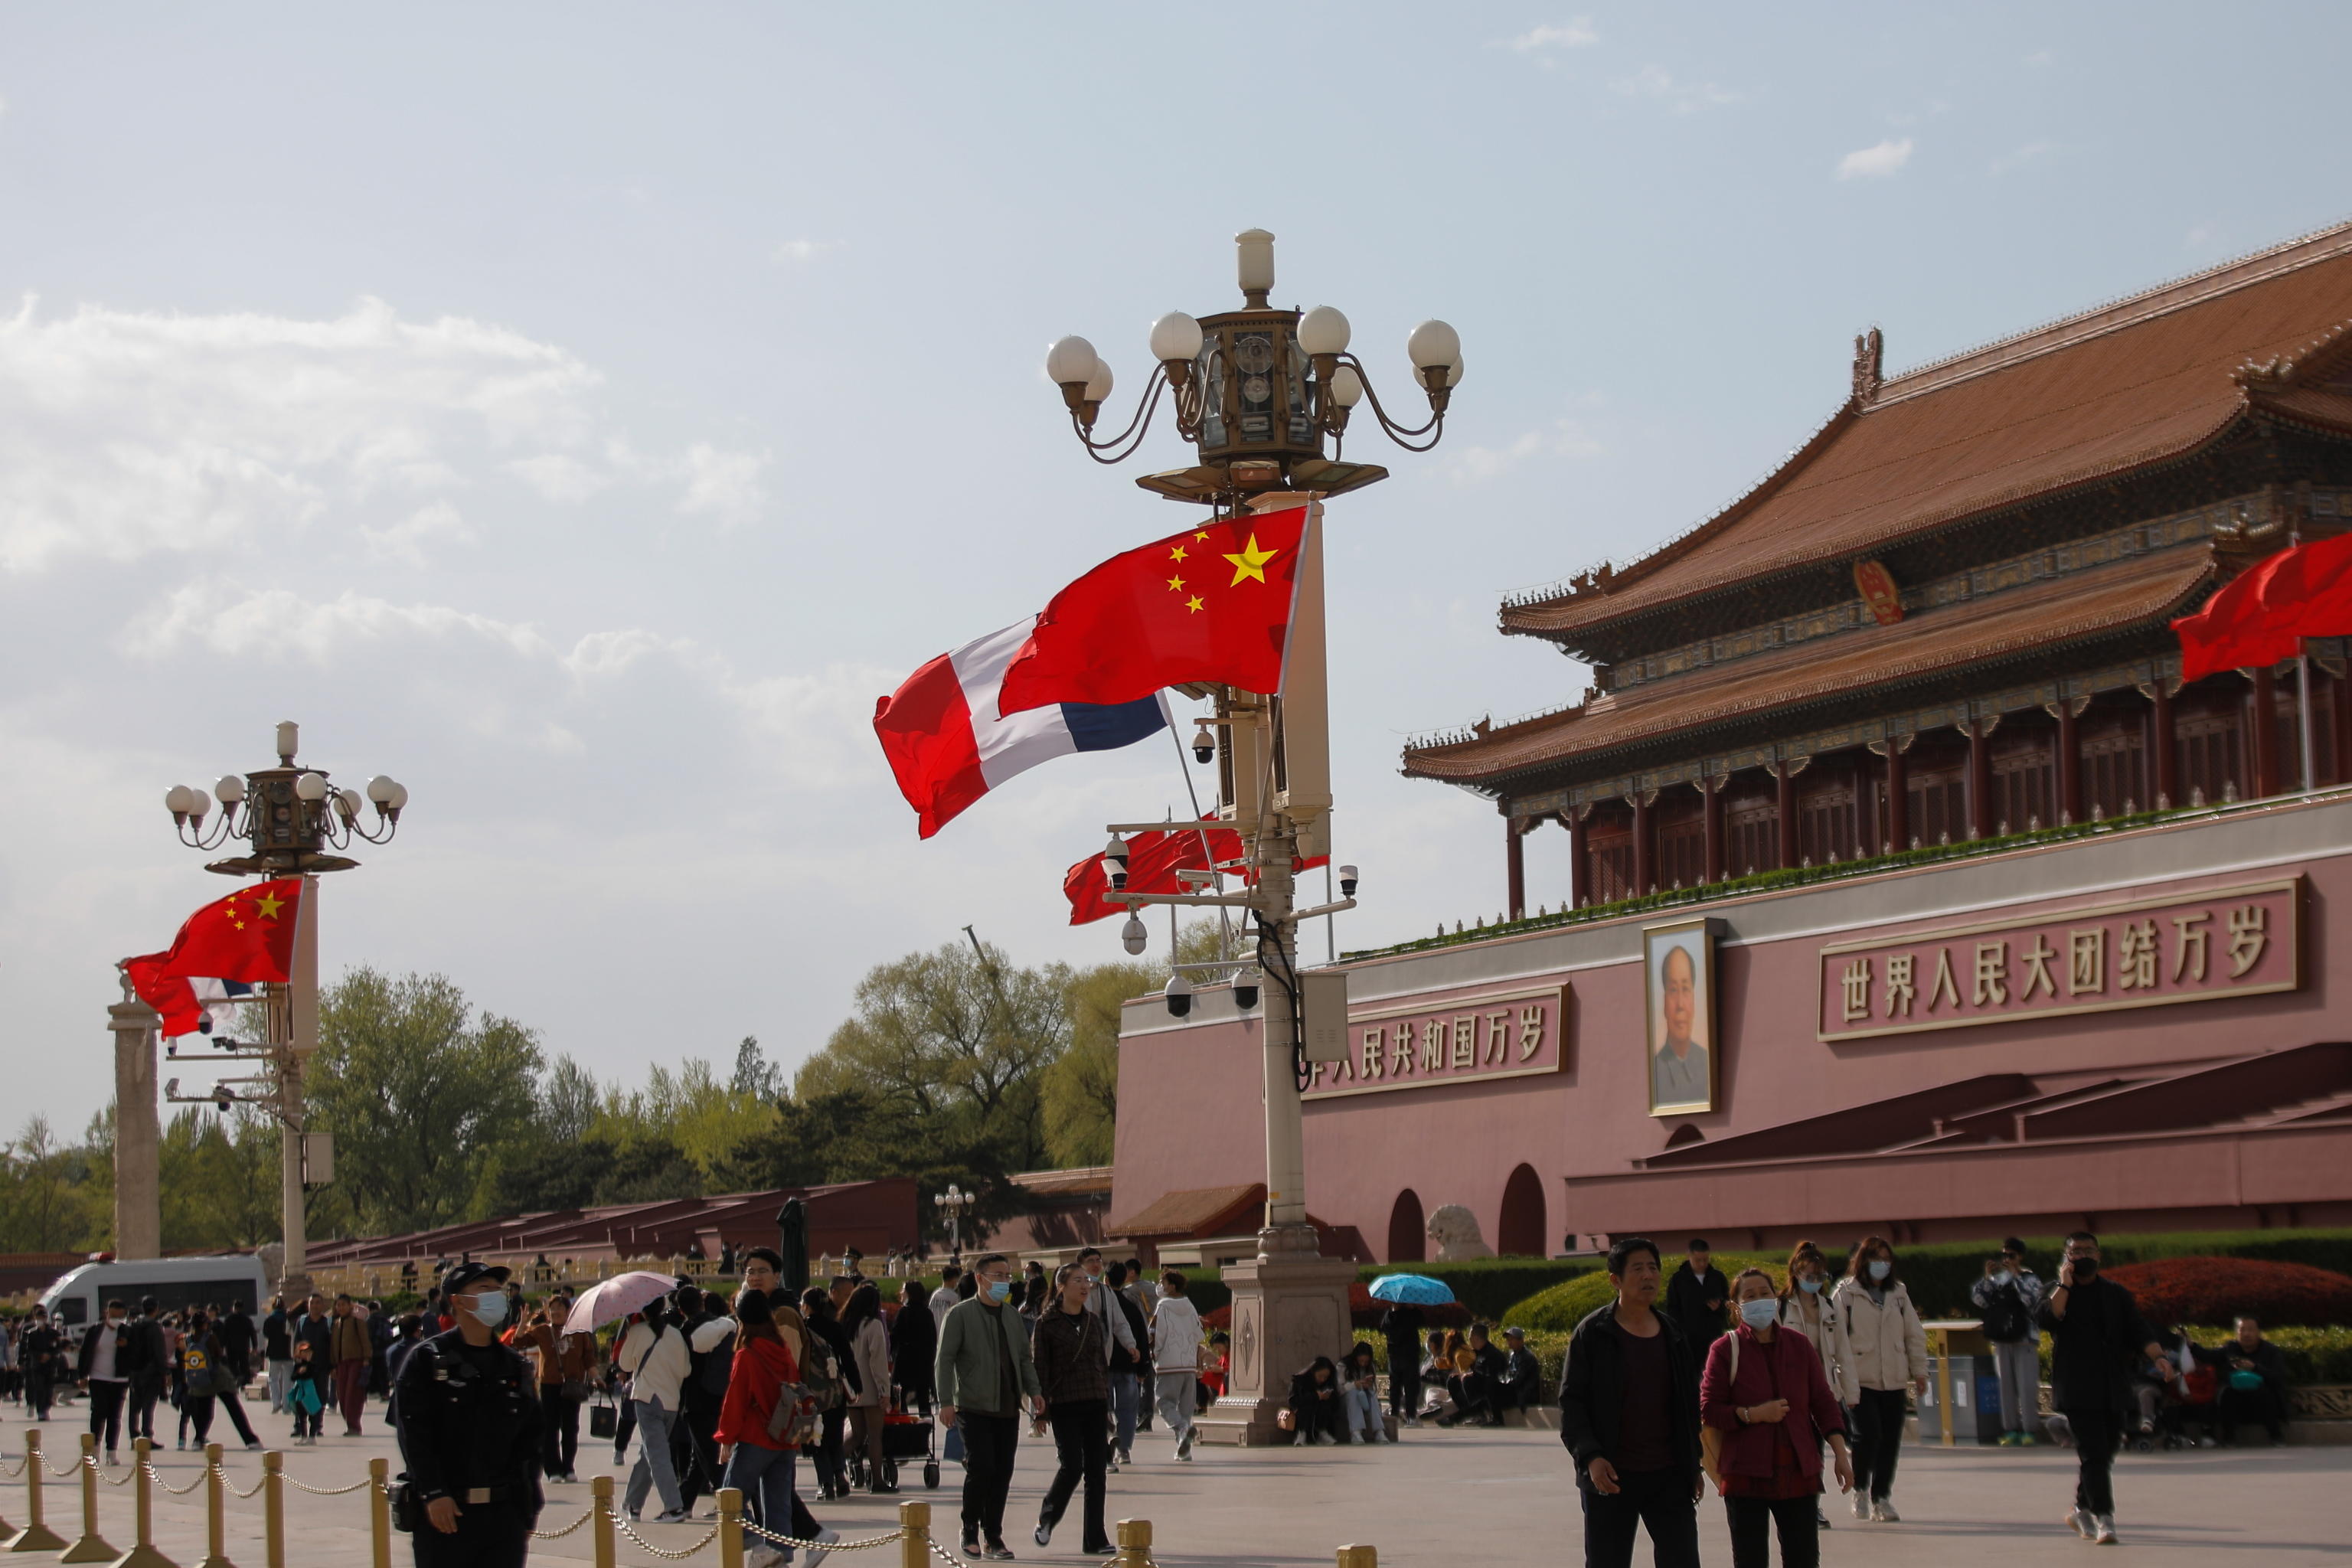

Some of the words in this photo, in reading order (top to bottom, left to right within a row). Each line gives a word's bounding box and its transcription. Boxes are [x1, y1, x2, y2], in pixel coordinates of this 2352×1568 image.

[1841, 905, 2267, 1024] 世界人民大团结万岁
[1312, 1005, 1543, 1086] 民共和国万岁
